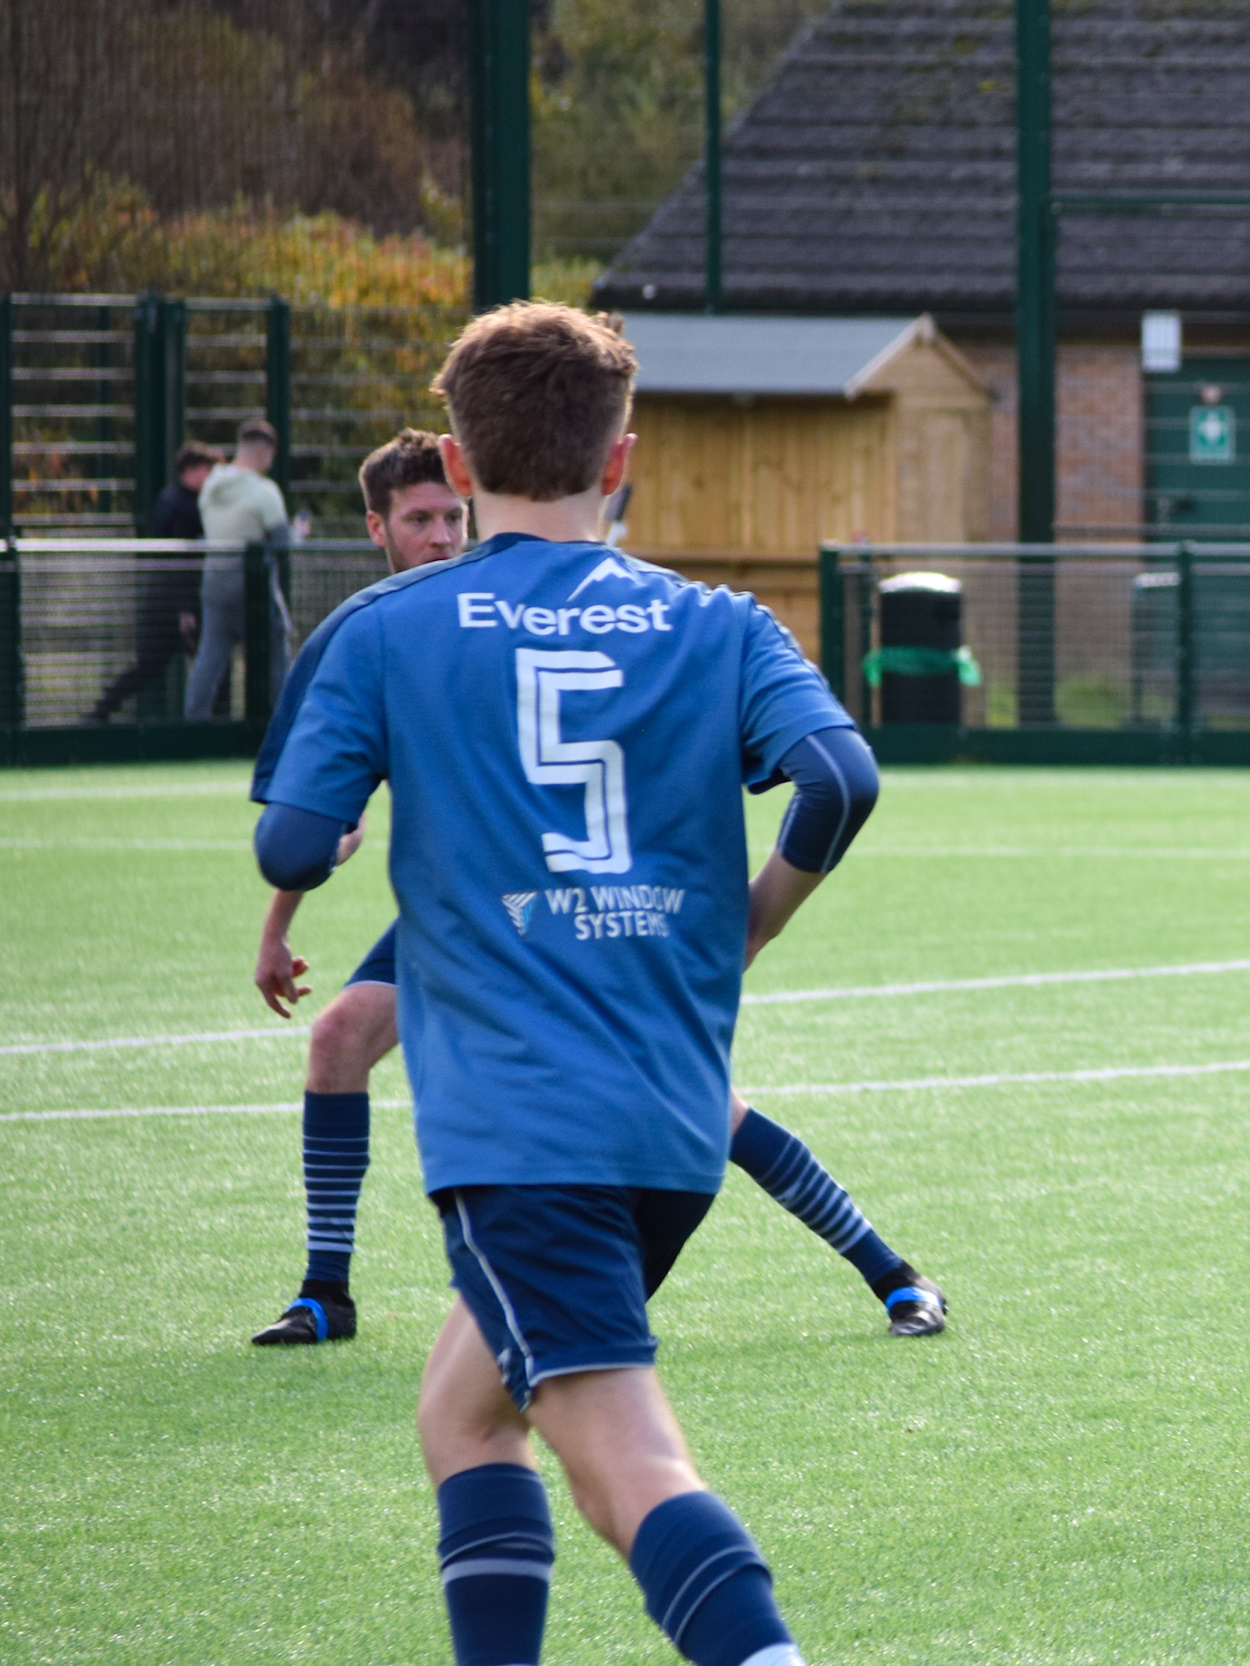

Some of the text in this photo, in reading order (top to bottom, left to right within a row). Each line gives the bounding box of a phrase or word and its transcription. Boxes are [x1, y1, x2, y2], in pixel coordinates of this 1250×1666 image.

[457, 592, 673, 635] Everest
[515, 648, 632, 874] 5
[544, 887, 588, 915] W2
